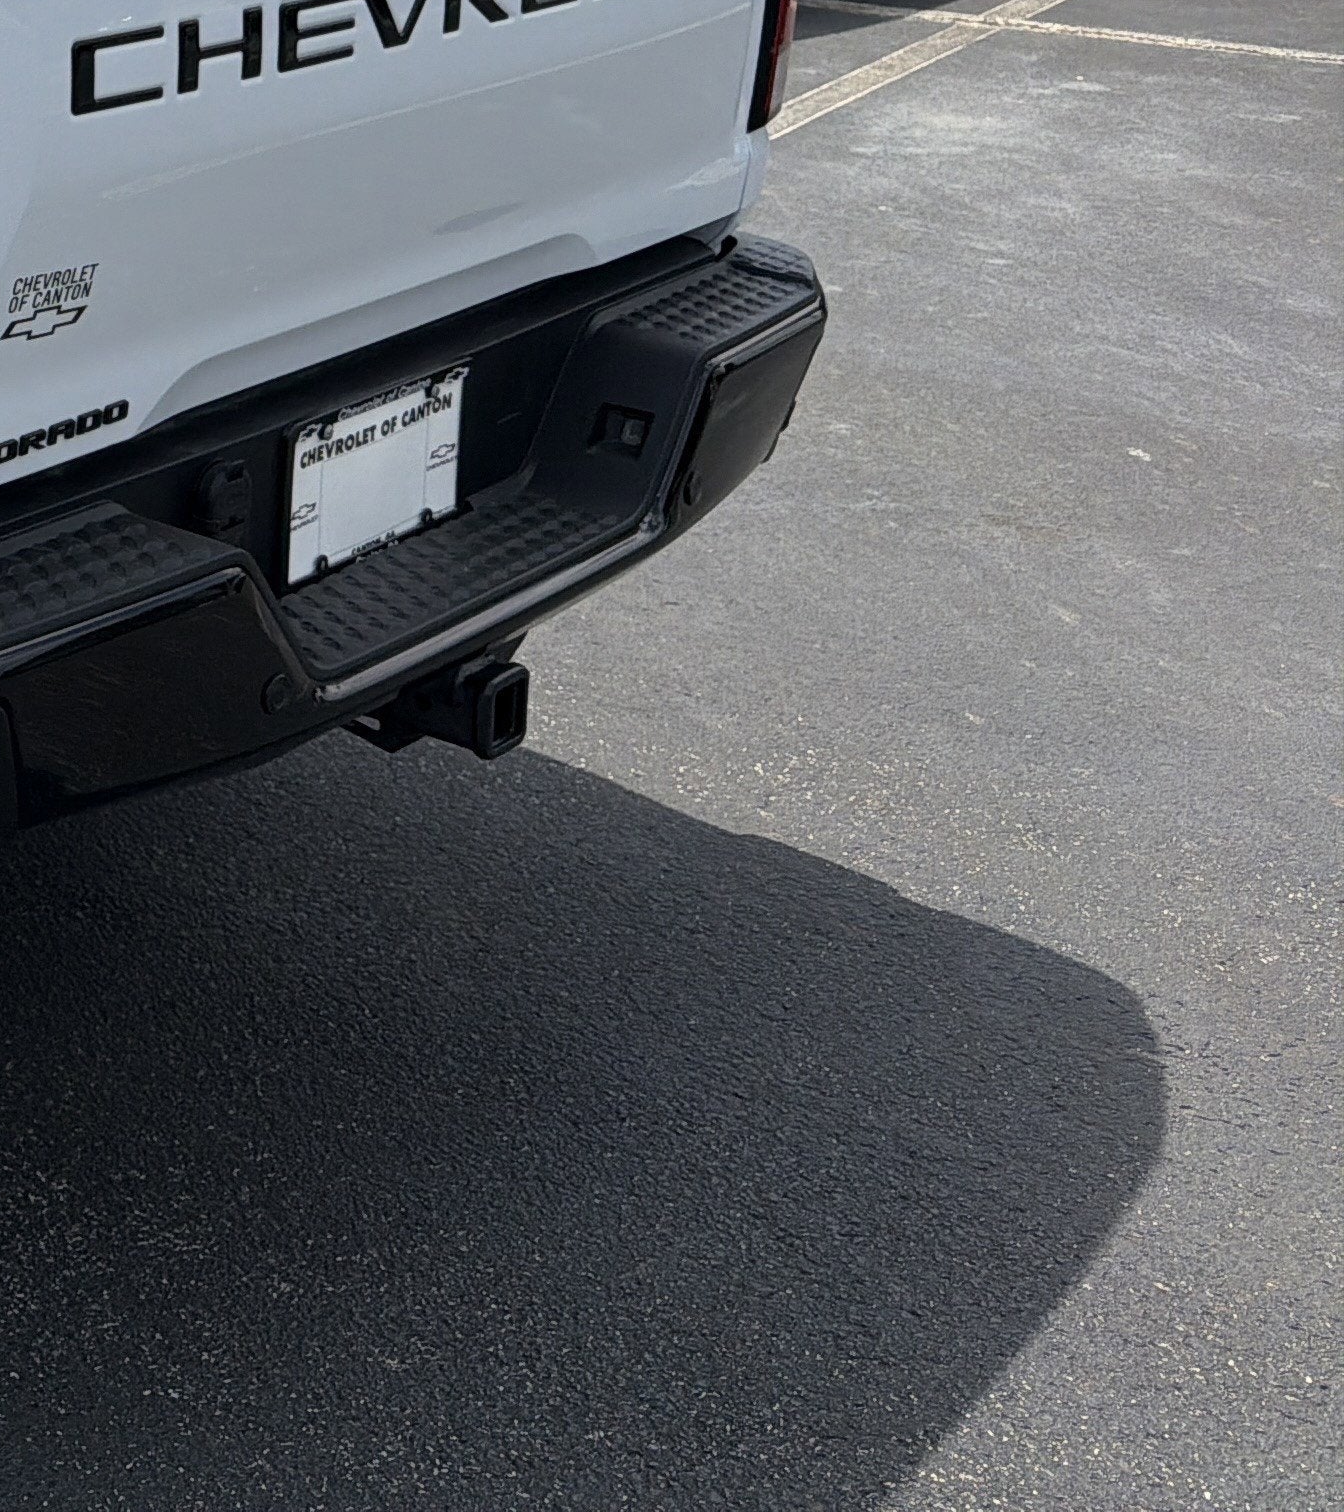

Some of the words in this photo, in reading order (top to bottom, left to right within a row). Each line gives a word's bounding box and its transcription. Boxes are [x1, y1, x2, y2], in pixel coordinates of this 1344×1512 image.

[12, 263, 99, 296] CHEVROLET
[8, 294, 30, 313] OF
[32, 281, 93, 309] CANTON
[300, 424, 377, 469] CHEVROLET
[380, 415, 398, 437] OF
[401, 392, 452, 428] CANTON
